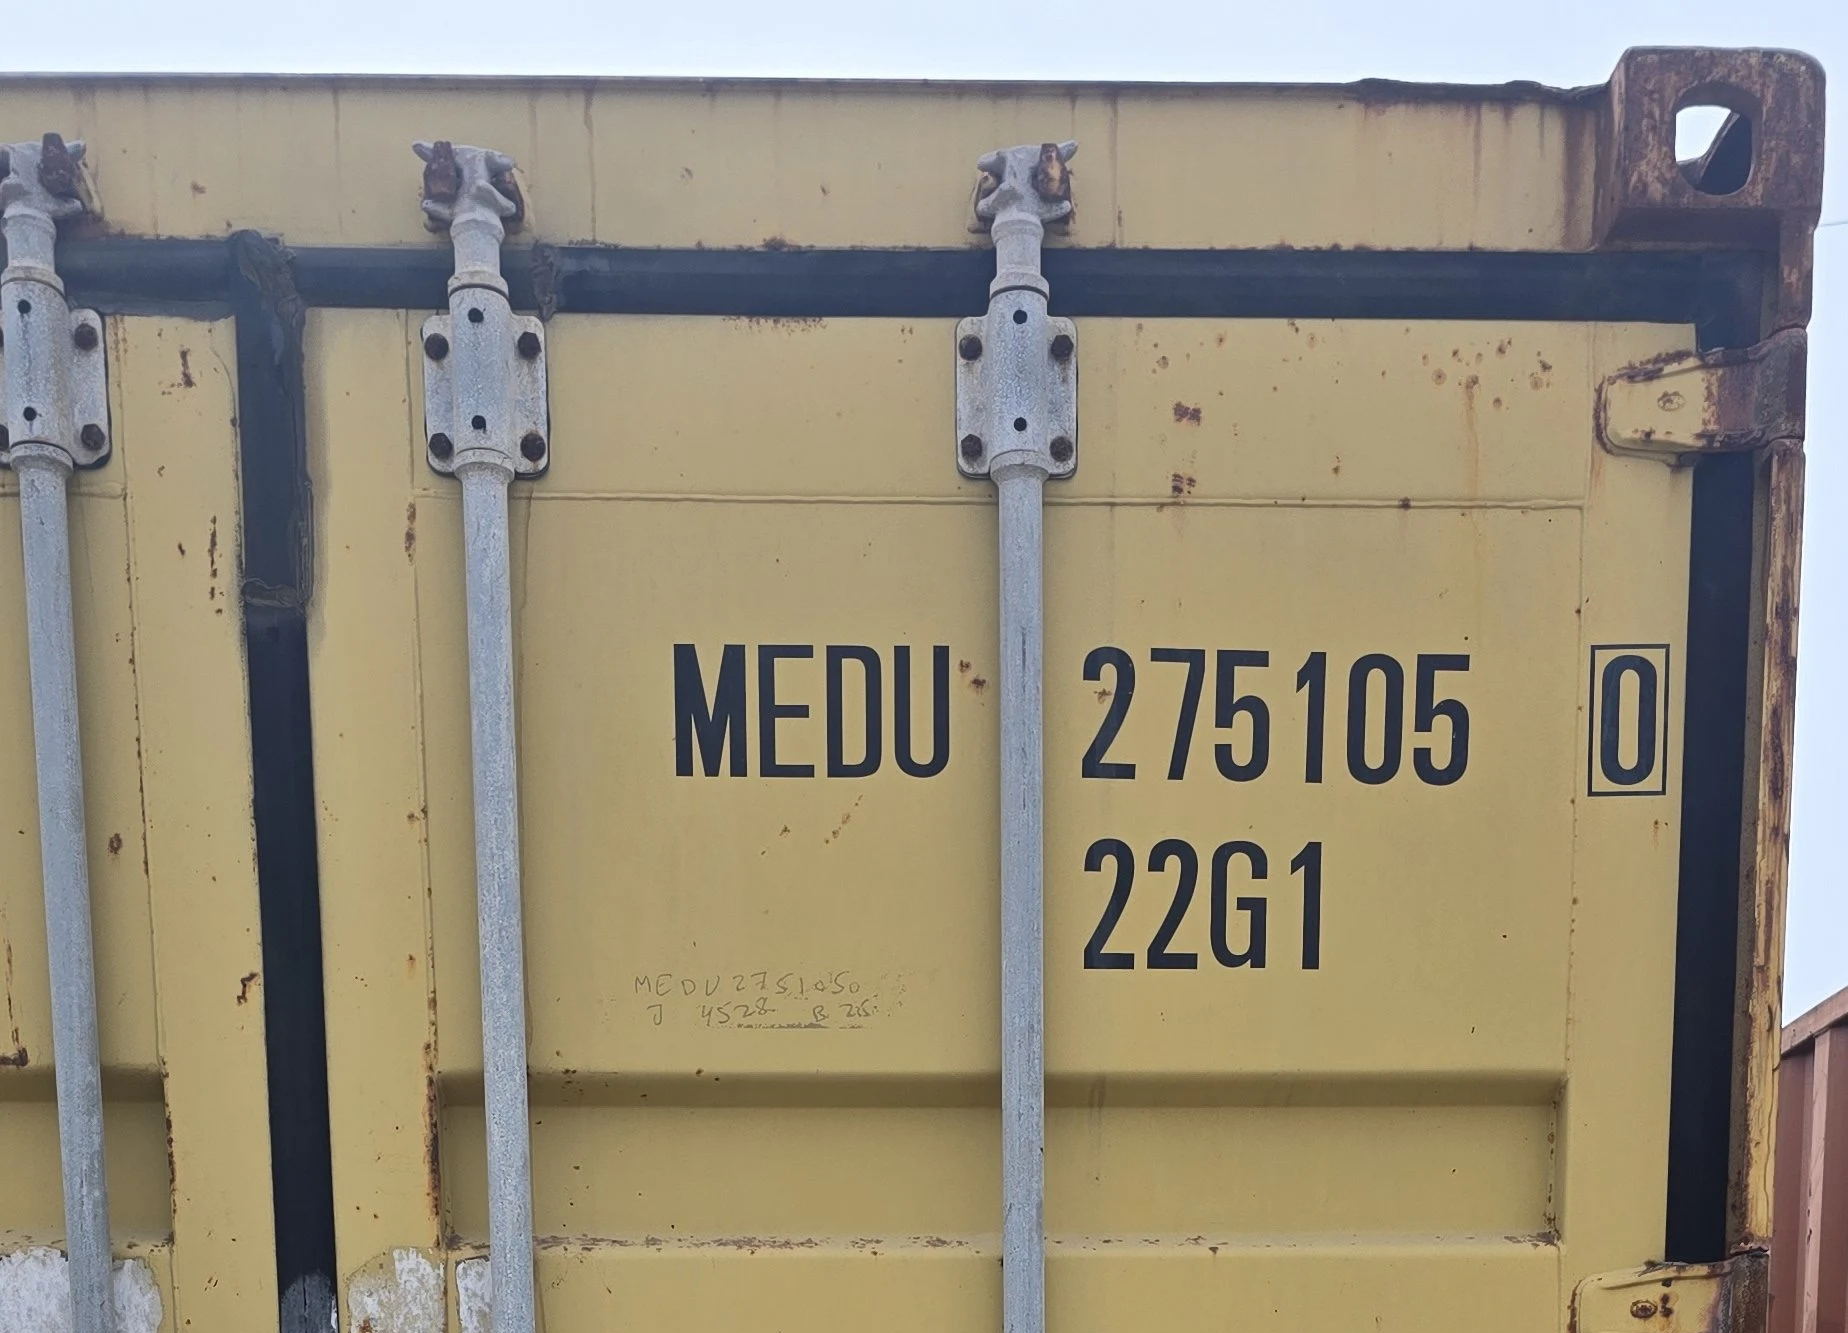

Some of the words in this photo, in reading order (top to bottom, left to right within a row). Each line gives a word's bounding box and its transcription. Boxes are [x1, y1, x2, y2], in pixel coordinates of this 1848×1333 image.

[673, 643, 950, 779] MEDU
[1081, 646, 1471, 786] 275105
[1600, 654, 1658, 786] 0
[1083, 838, 1322, 970] 22G1
